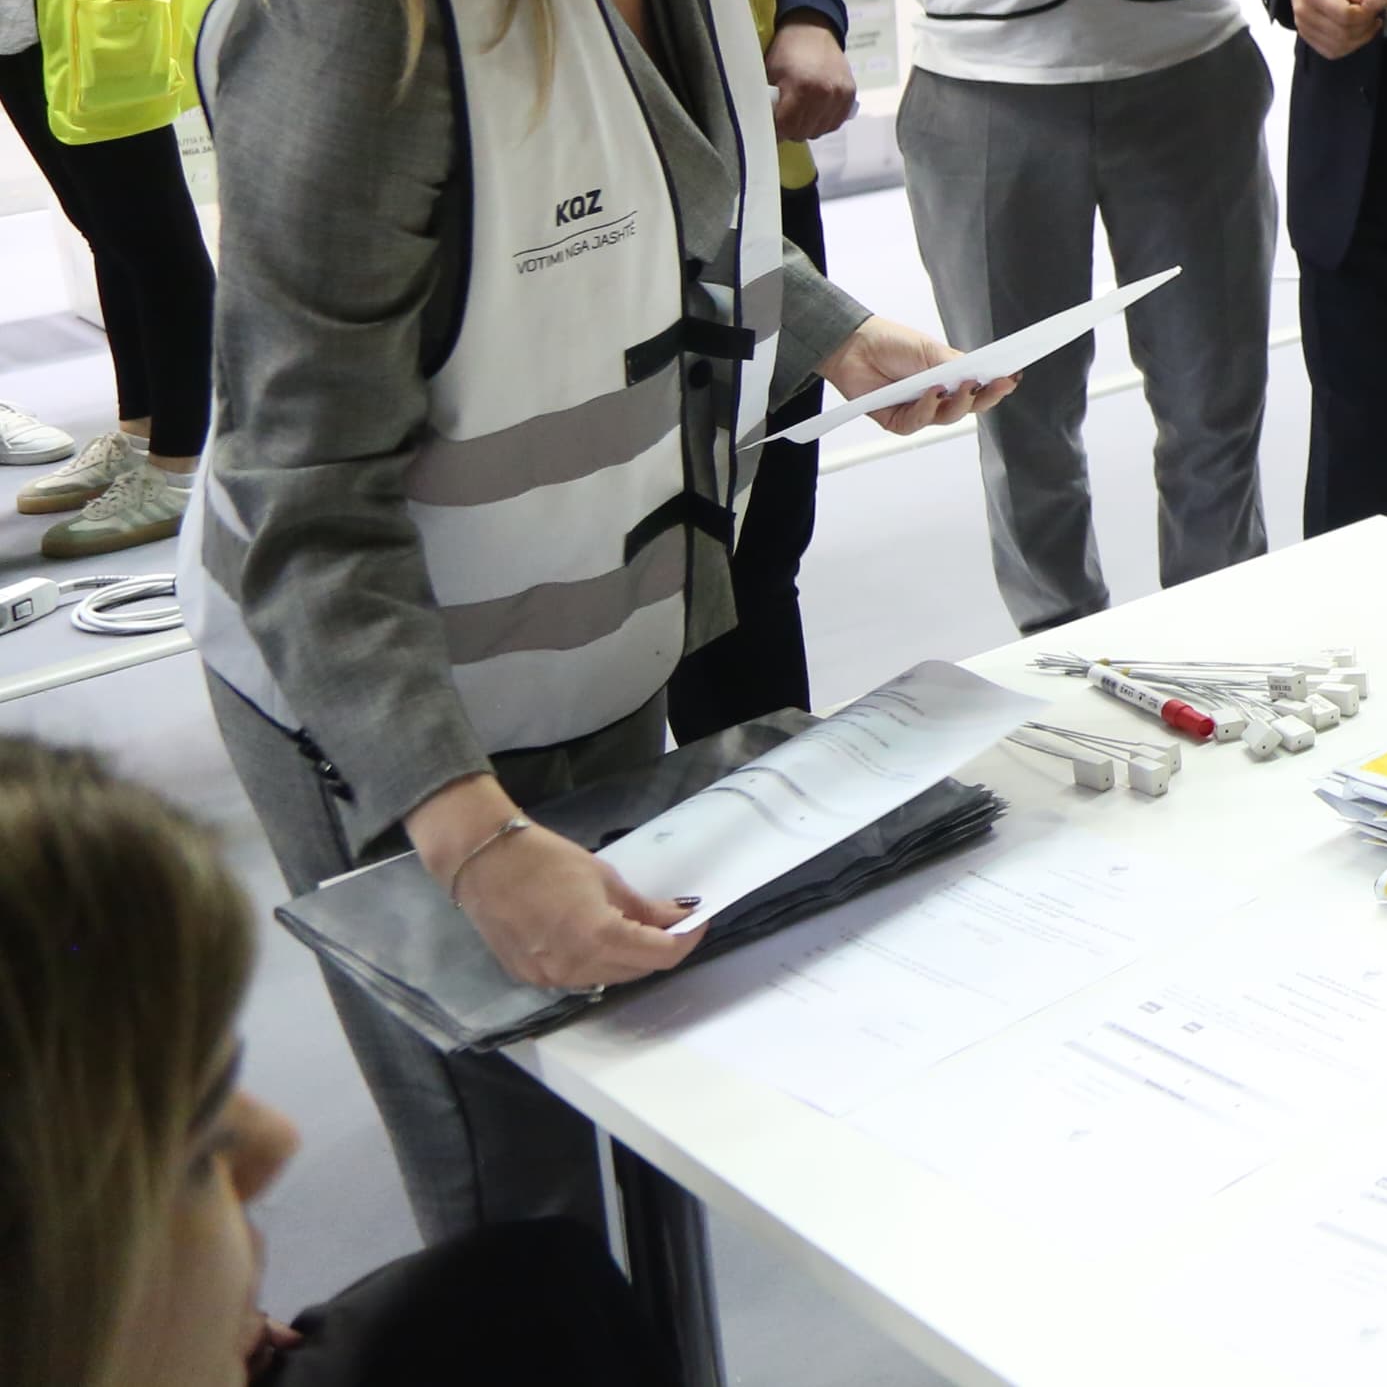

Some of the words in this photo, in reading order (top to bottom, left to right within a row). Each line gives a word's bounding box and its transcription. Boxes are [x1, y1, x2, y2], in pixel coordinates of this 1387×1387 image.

[555, 189, 603, 227] KQZ
[516, 255, 565, 274] VOTIMI
[565, 242, 591, 259] NGA
